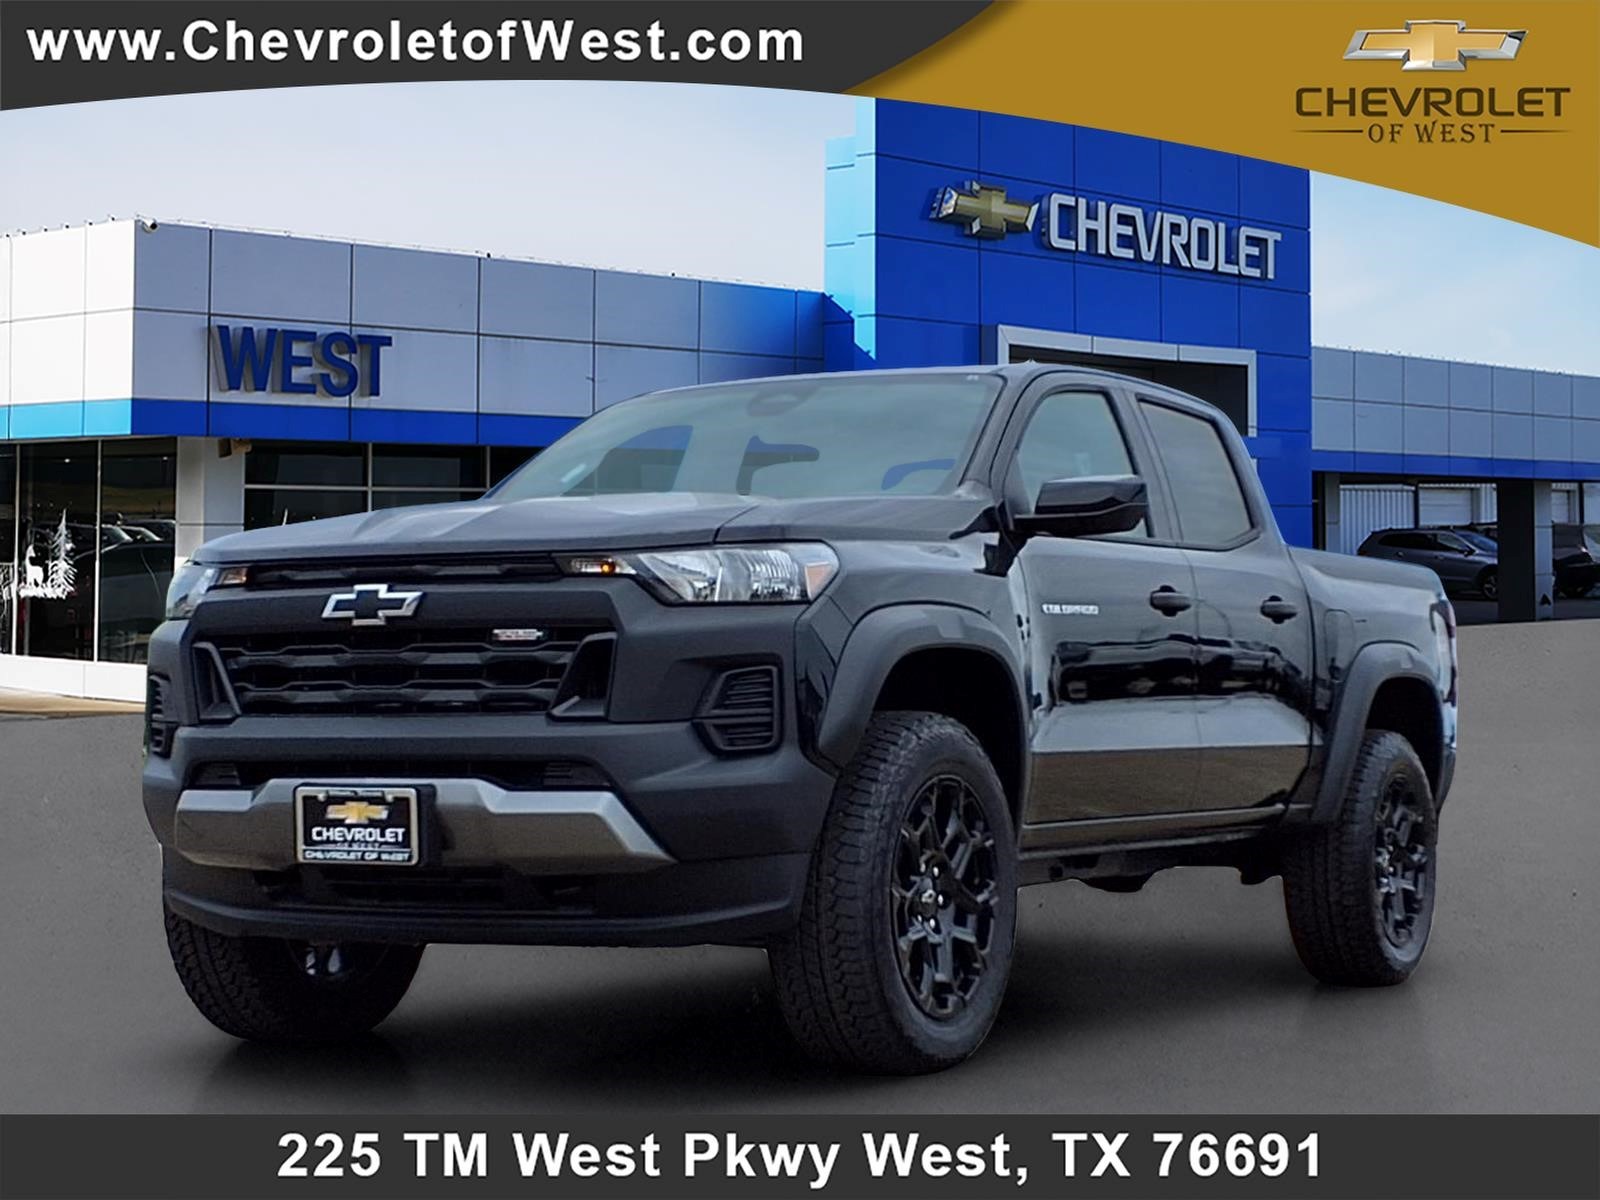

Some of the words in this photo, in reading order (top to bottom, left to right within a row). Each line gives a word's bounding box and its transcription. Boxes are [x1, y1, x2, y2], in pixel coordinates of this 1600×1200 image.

[1046, 192, 1282, 280] CHEVROLET
[211, 324, 393, 398] WEST
[311, 827, 405, 842] CHEVROLET
